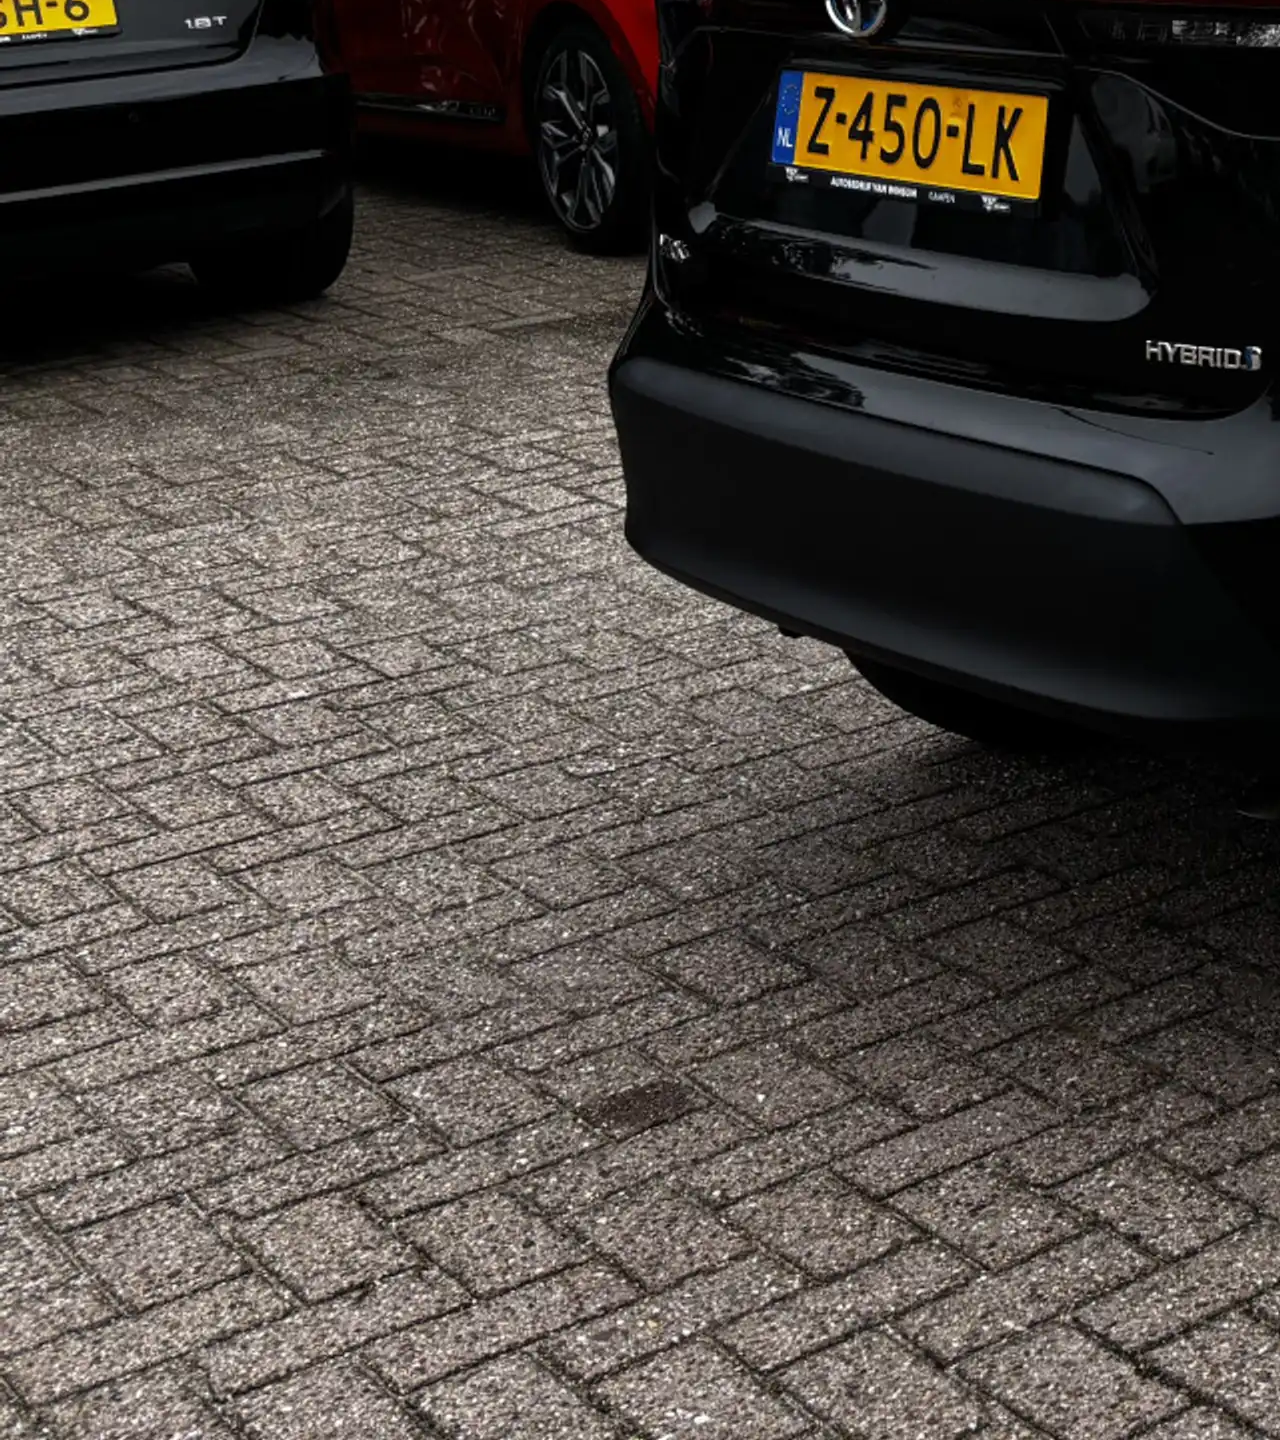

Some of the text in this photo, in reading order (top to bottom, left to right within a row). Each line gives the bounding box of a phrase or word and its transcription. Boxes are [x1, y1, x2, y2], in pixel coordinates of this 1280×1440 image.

[776, 128, 793, 148] NL
[807, 86, 1023, 182] Z-450-LK
[1146, 340, 1242, 369] HYBRID
